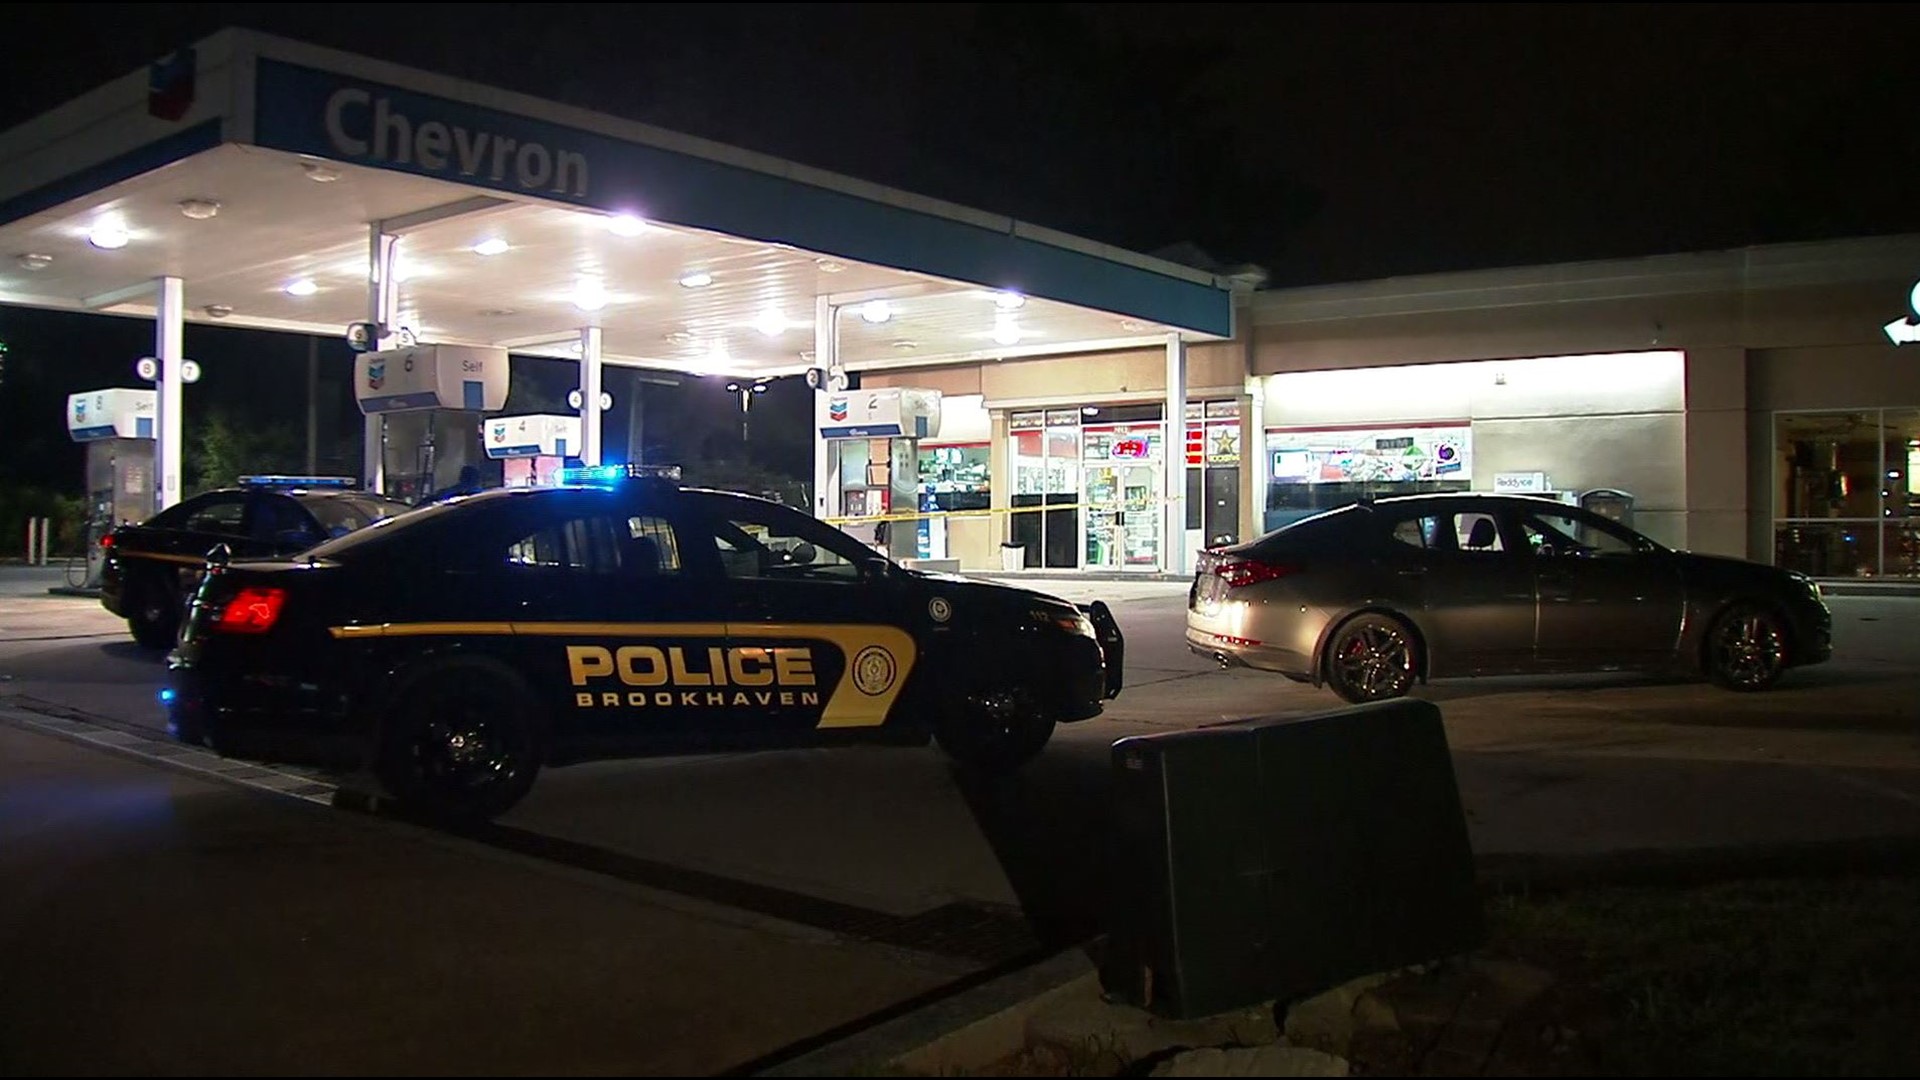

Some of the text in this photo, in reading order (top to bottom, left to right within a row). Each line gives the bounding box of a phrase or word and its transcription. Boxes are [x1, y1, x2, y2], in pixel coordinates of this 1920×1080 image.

[325, 87, 589, 198] Chevron
[142, 362, 152, 374] 8
[404, 353, 414, 372] 6
[462, 359, 483, 373] Self
[185, 366, 193, 376] 7
[868, 393, 878, 409] 2
[566, 646, 816, 686] POLICE
[576, 692, 819, 707] BROOKHAVEN
